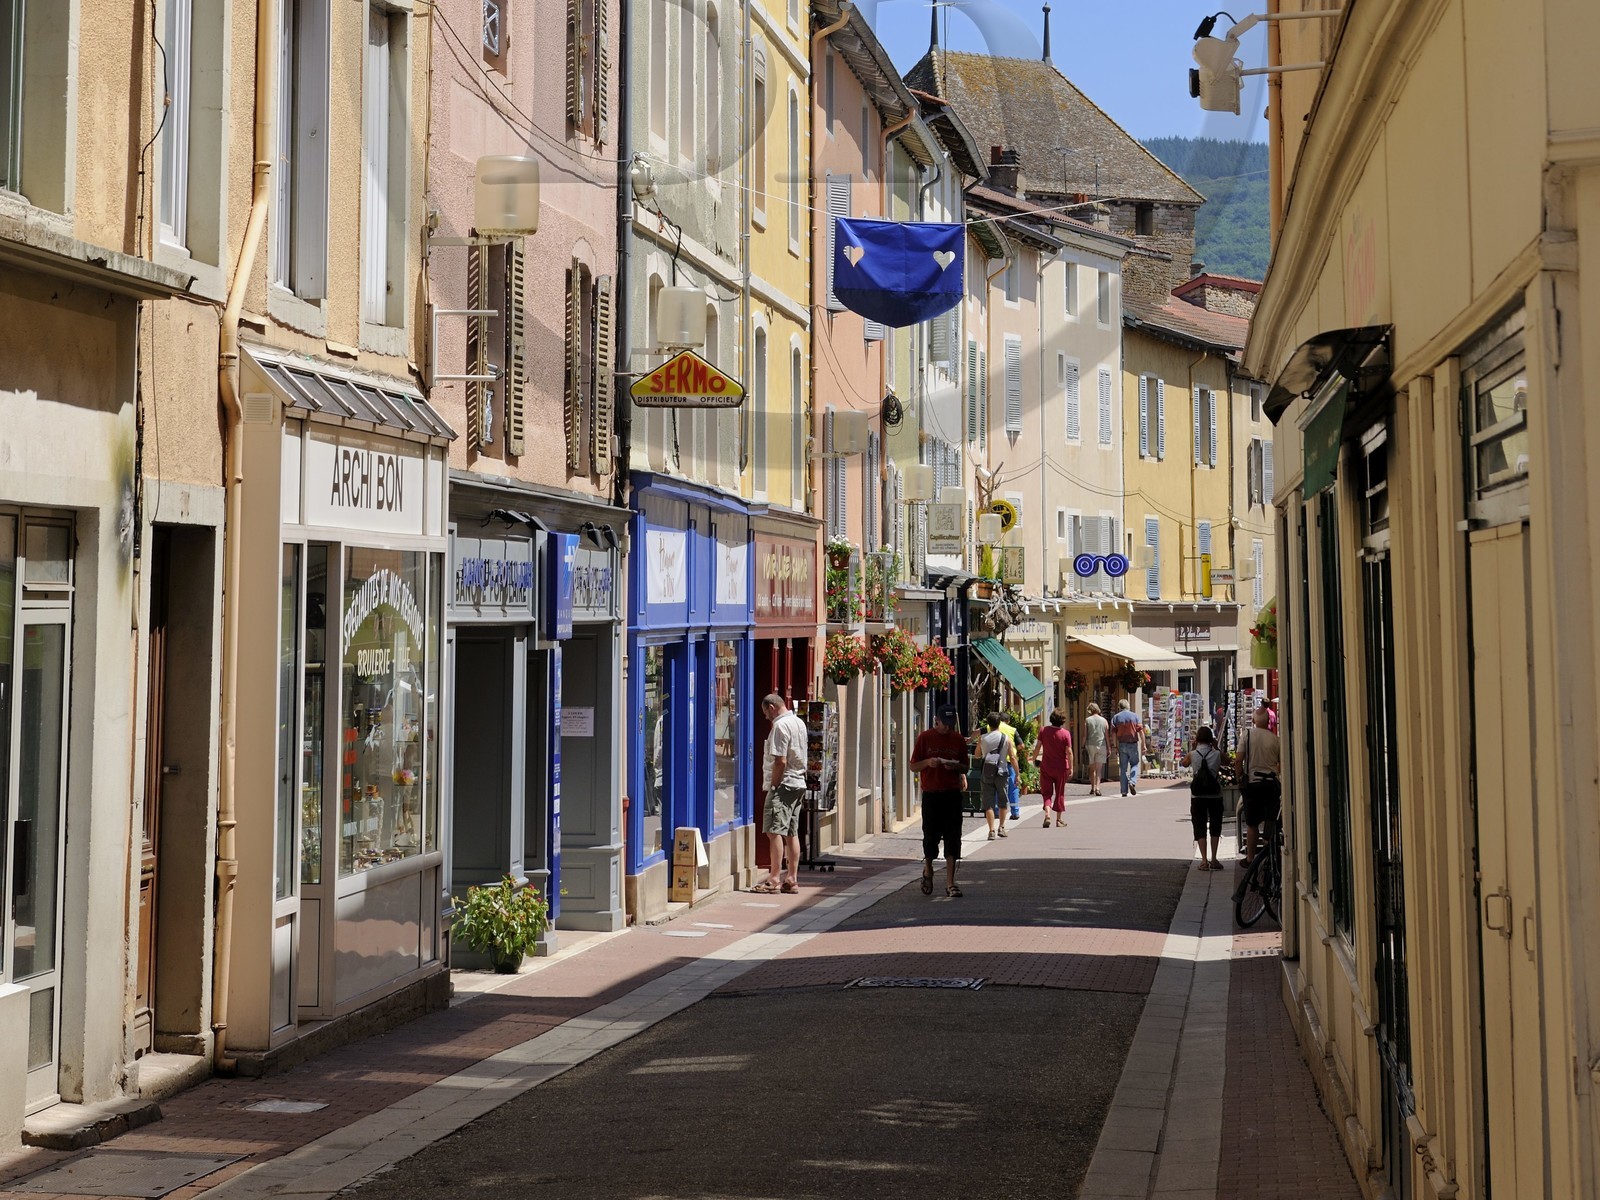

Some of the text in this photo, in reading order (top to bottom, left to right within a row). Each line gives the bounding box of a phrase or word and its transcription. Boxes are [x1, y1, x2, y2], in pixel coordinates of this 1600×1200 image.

[649, 354, 727, 394] SERMO
[700, 396, 735, 404] OFFICIEL
[331, 447, 404, 512] ARCHI BON
[343, 563, 424, 656] SPÉCIALITÉS DE NOS RÉGIONS
[1090, 615, 1109, 630] WOLFF
[357, 648, 391, 678] BRULERIE
